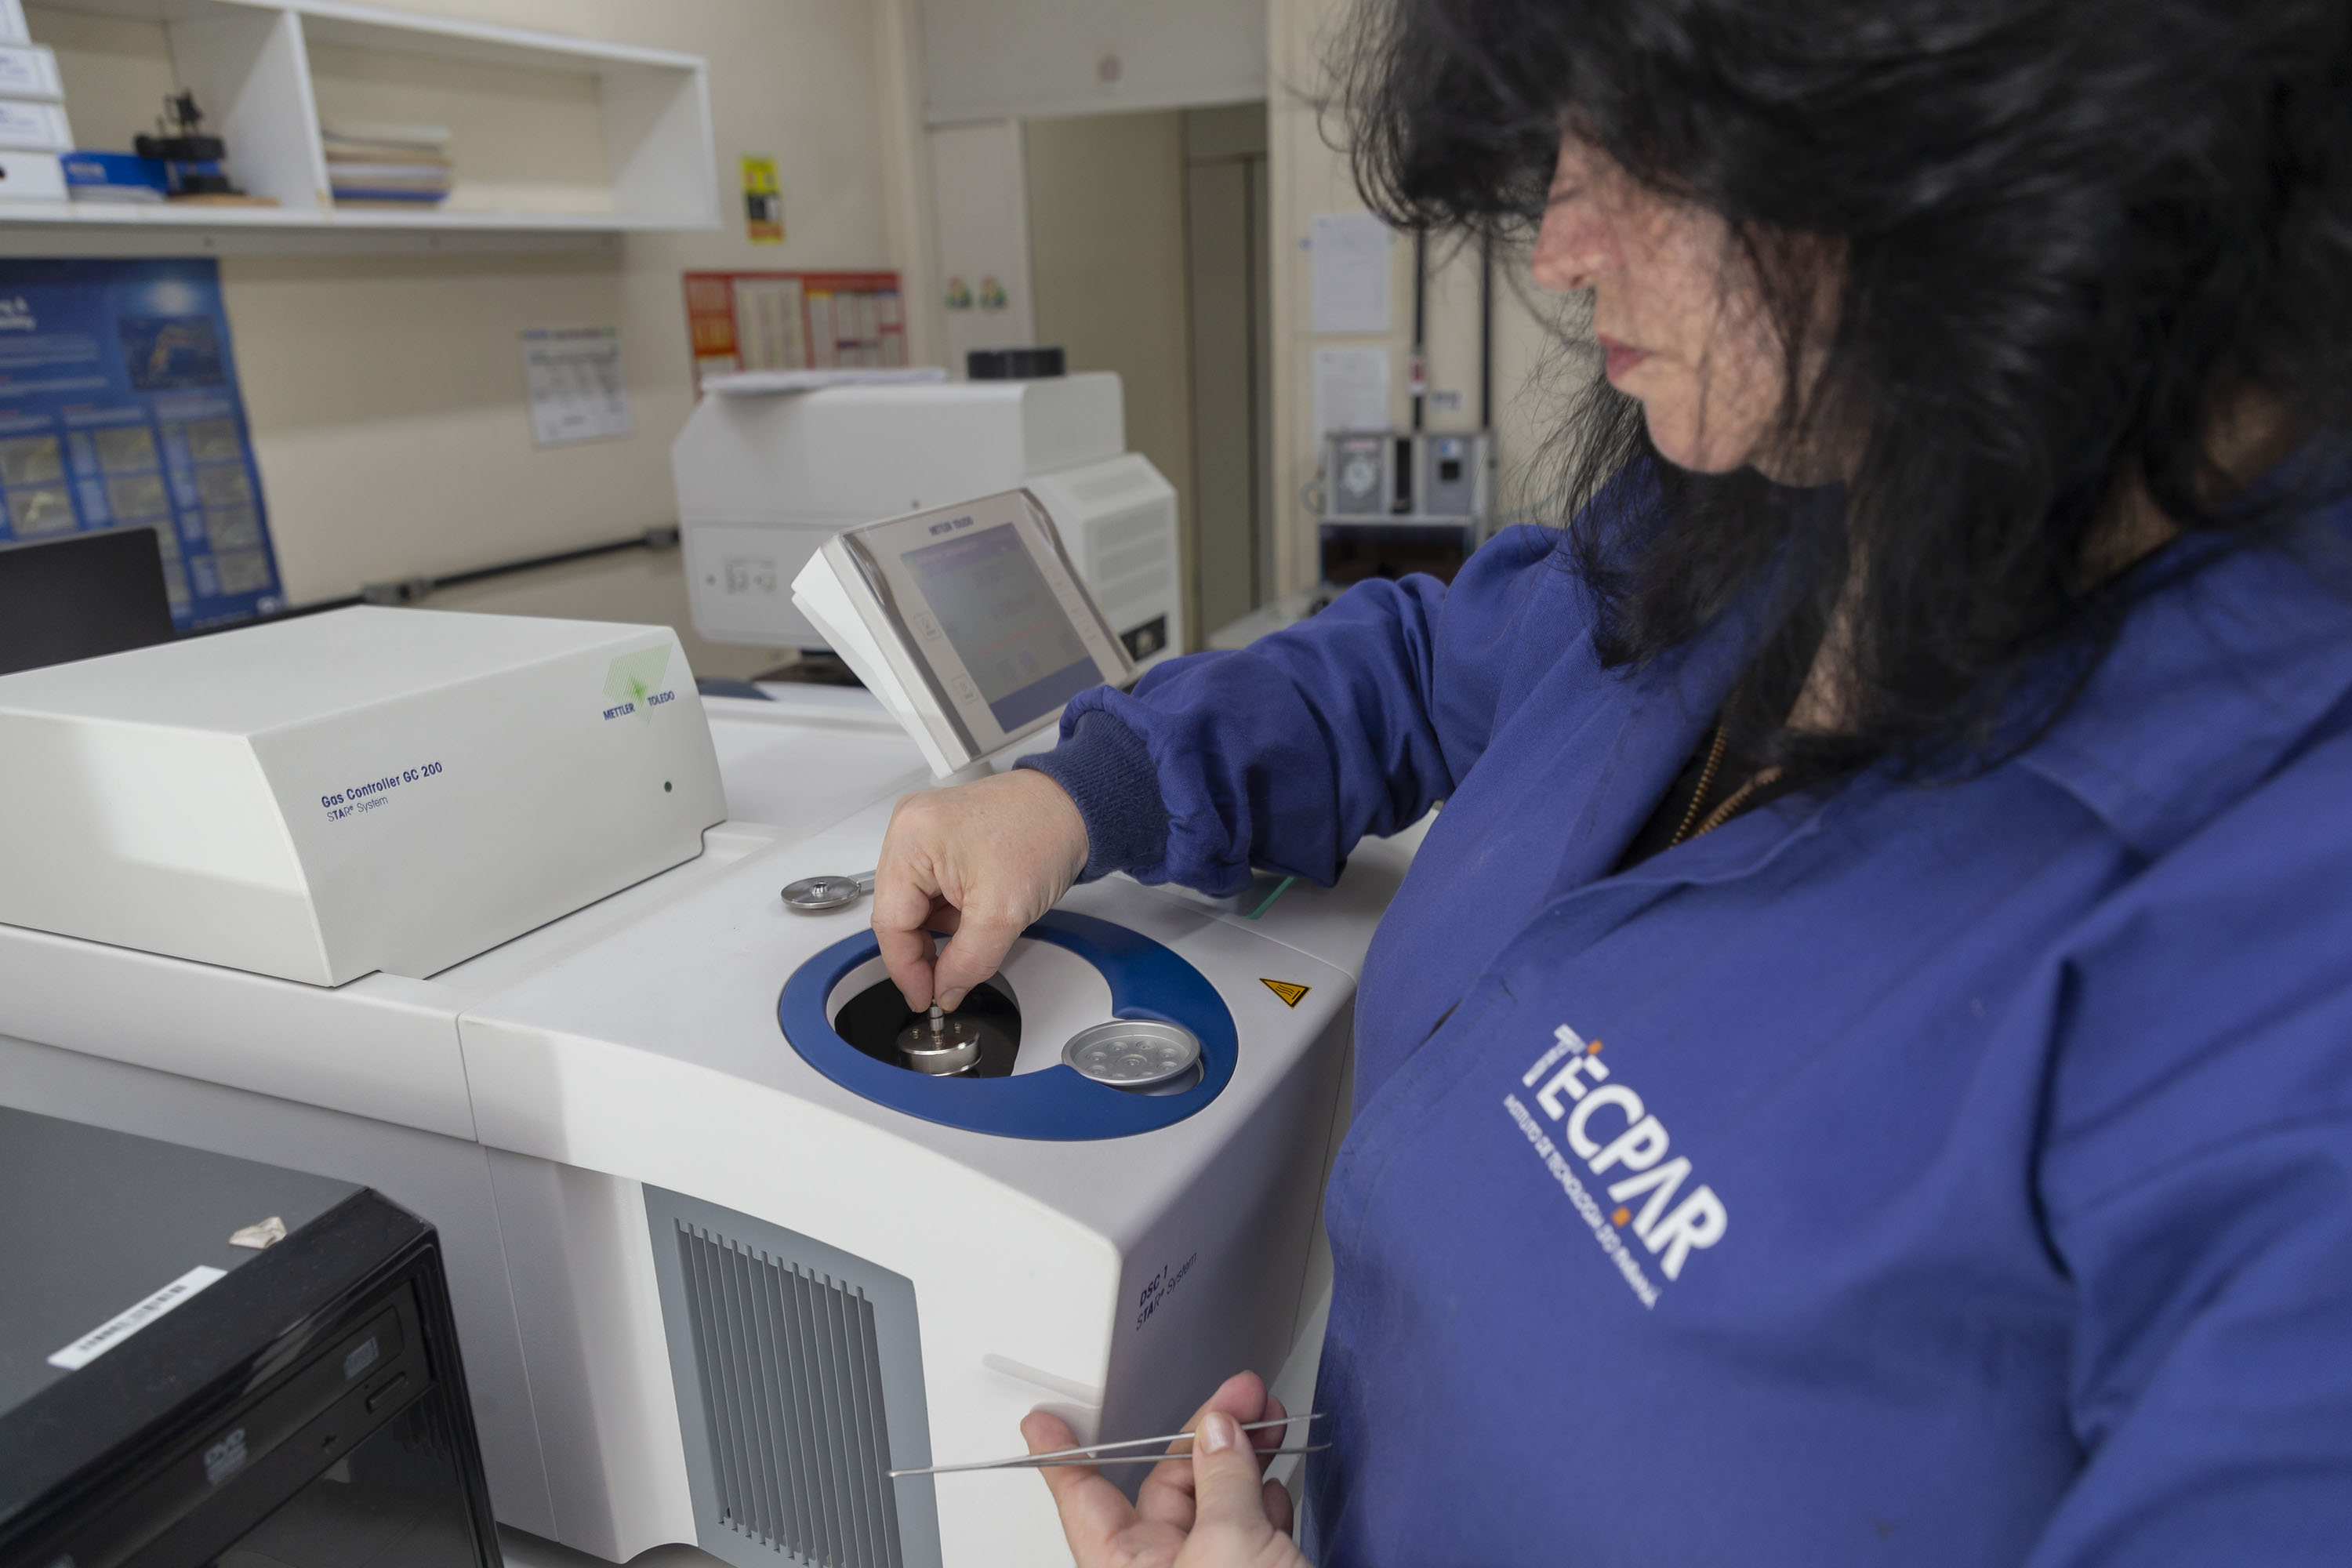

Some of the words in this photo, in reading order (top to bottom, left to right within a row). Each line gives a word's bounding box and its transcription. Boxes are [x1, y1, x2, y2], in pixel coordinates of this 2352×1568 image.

[603, 702, 635, 720] METTLER
[648, 691, 675, 706] TOLEDO
[321, 793, 344, 808] Gas
[346, 775, 401, 800] Controller
[403, 769, 419, 782] GC
[421, 761, 443, 777] 200
[357, 797, 388, 813] System
[1522, 1024, 1729, 1281] TECPAR
[1140, 1273, 1160, 1308] DSC
[1163, 1263, 1168, 1280] 1
[1167, 1252, 1197, 1295] System
[205, 1428, 245, 1465] DVD
